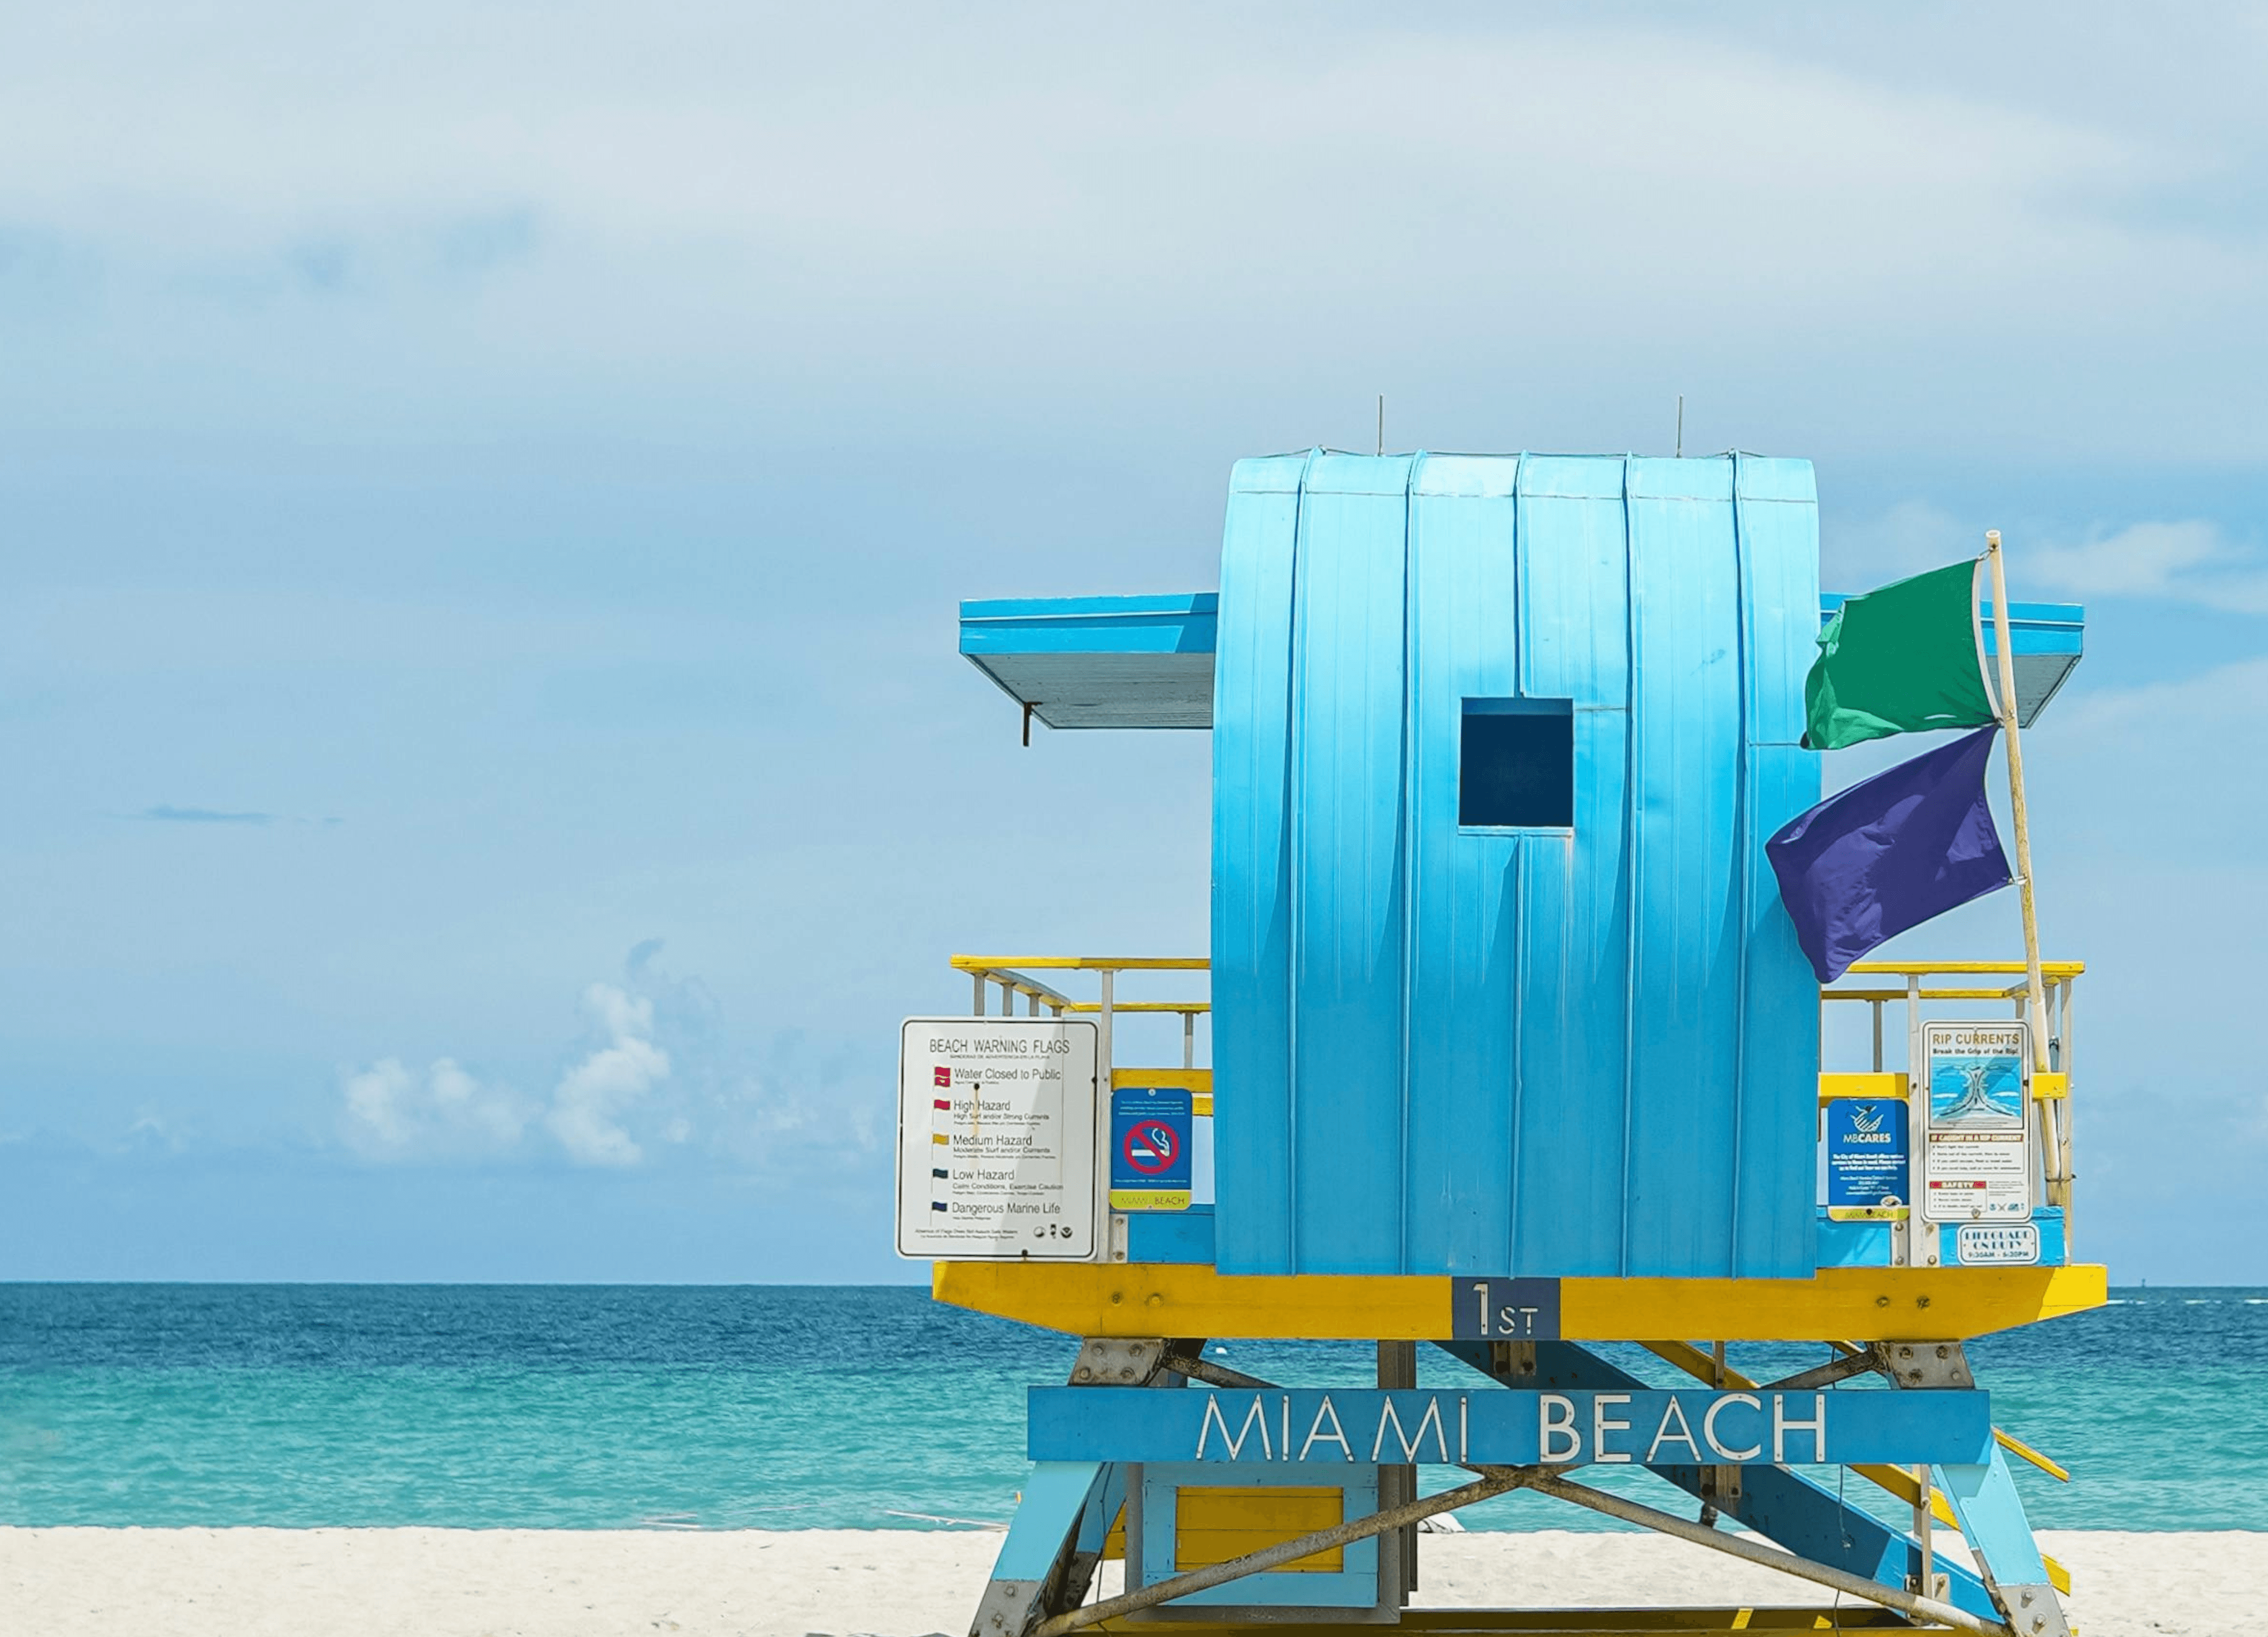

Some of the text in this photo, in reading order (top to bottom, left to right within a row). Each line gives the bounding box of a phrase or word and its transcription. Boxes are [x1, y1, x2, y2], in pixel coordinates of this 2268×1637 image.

[1933, 1033, 2020, 1045] RIP CURRENTS
[930, 1039, 1070, 1054] BEACH WARNING FLAGS
[954, 1068, 1061, 1080] Water Closed to Public
[954, 1100, 1011, 1113] High Hazard
[954, 1134, 1033, 1146] Medium Hazard
[953, 1169, 1015, 1181] Low Hazard
[1155, 1196, 1185, 1205] BEACH
[952, 1202, 1061, 1216] Dangerous Marine Life
[1473, 1283, 1539, 1335] 1ST
[1195, 1392, 1826, 1463] MIAMI BEACH
